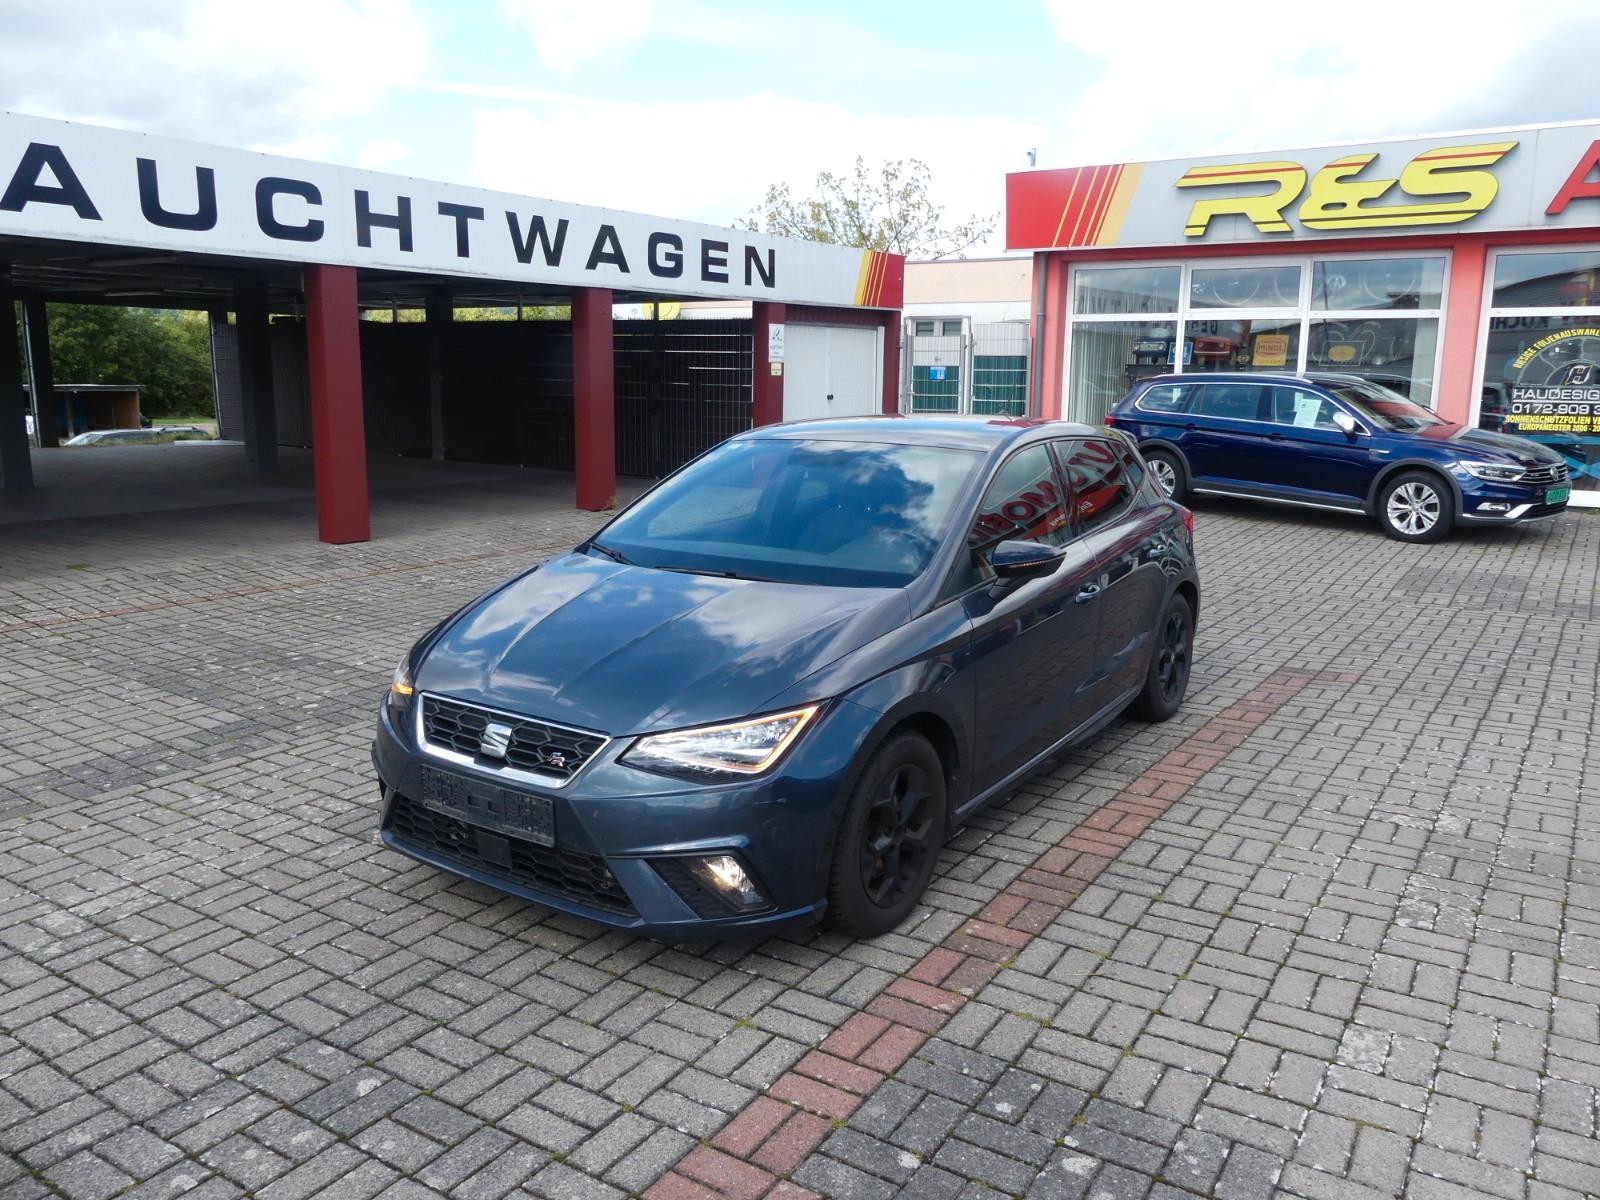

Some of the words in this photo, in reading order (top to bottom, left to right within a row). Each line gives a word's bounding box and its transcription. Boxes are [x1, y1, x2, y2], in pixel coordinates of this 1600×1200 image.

[1175, 141, 1519, 236] R&S
[0, 142, 776, 288] AUCHTWAGEN
[1513, 388, 1600, 400] HAUDESIG
[1505, 415, 1591, 425] SONNENSCHUTZFOLIEN
[1518, 423, 1571, 431] EUROPAMEISTER
